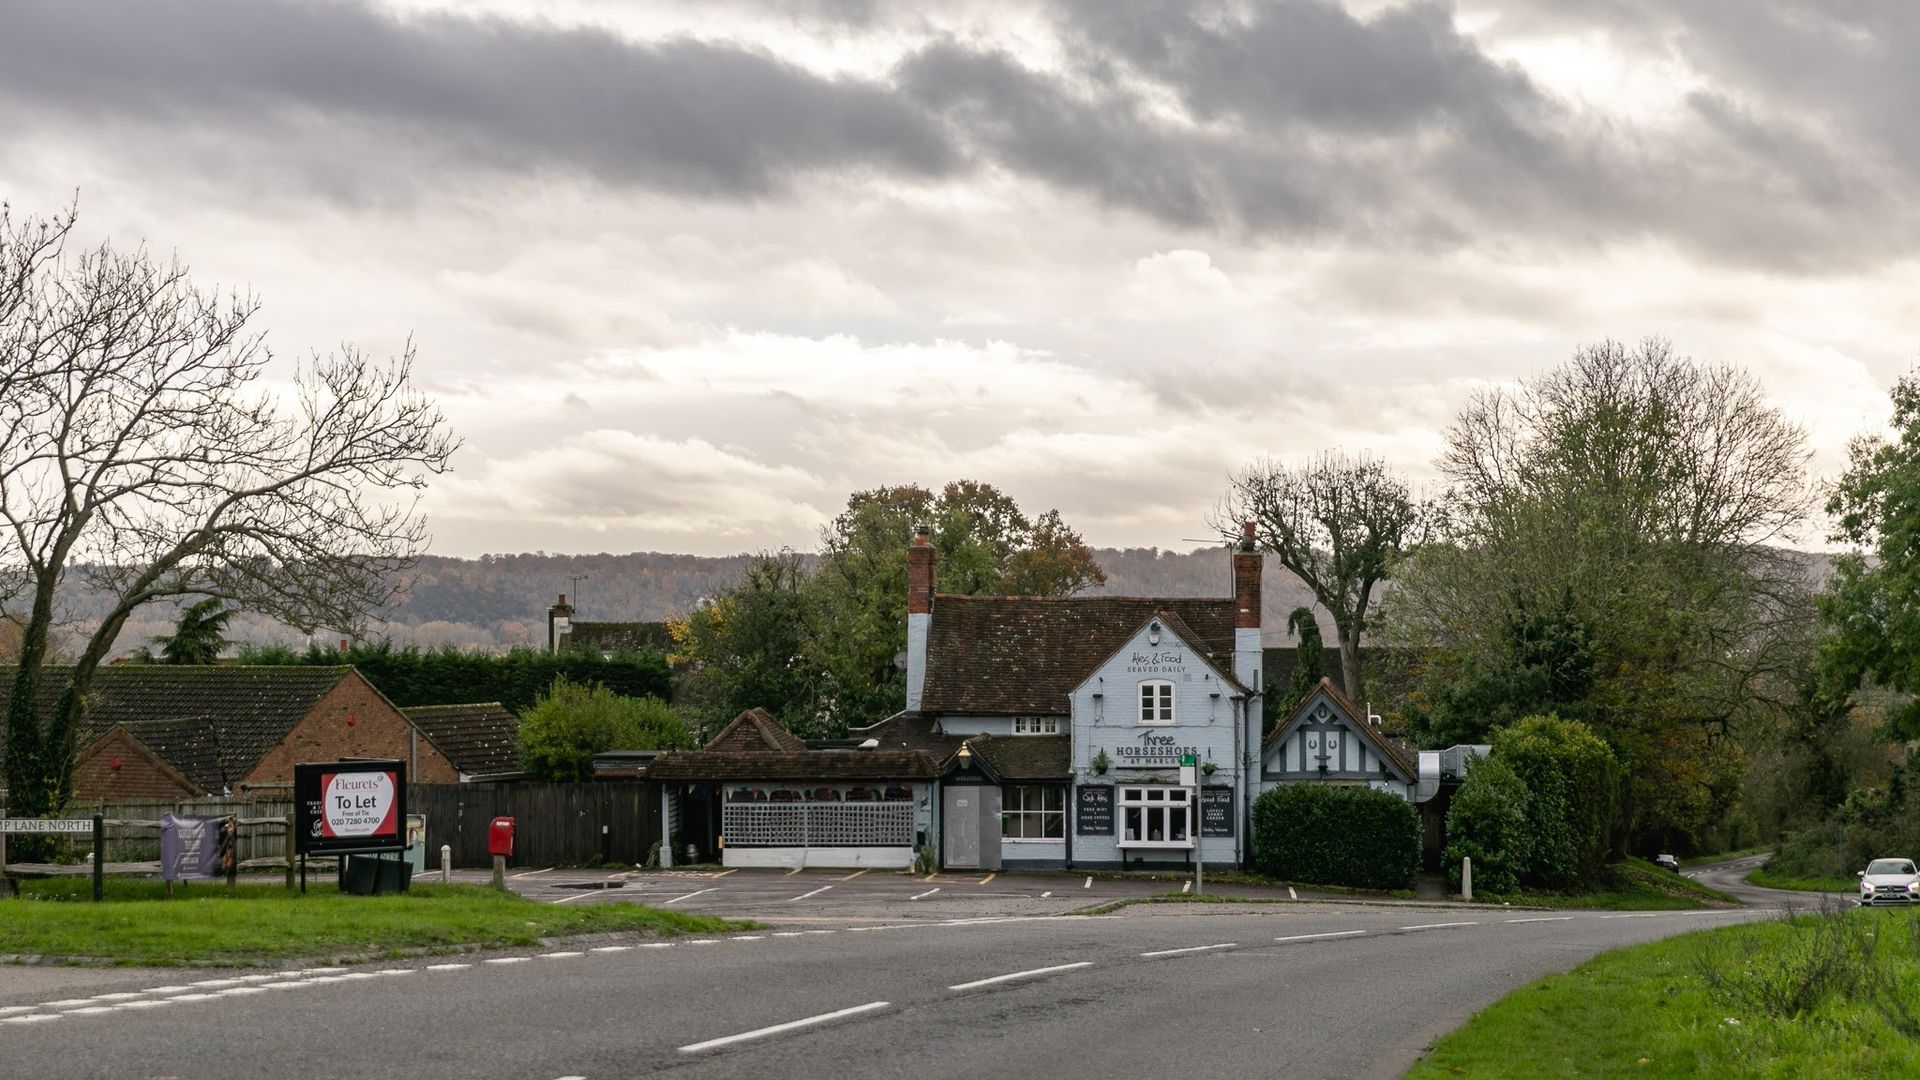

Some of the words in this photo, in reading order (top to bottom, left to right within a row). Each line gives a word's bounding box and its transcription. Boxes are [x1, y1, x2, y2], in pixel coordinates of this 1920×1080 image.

[1152, 652, 1160, 665] &
[1161, 651, 1182, 664] Food
[1137, 728, 1176, 746] Three
[1116, 746, 1197, 755] HORSESHOES
[335, 778, 379, 790] Fleurets
[335, 796, 351, 809] To
[355, 795, 377, 808] Let
[15, 821, 44, 831] LANE
[48, 821, 91, 831] NORTH
[331, 818, 344, 826] 020
